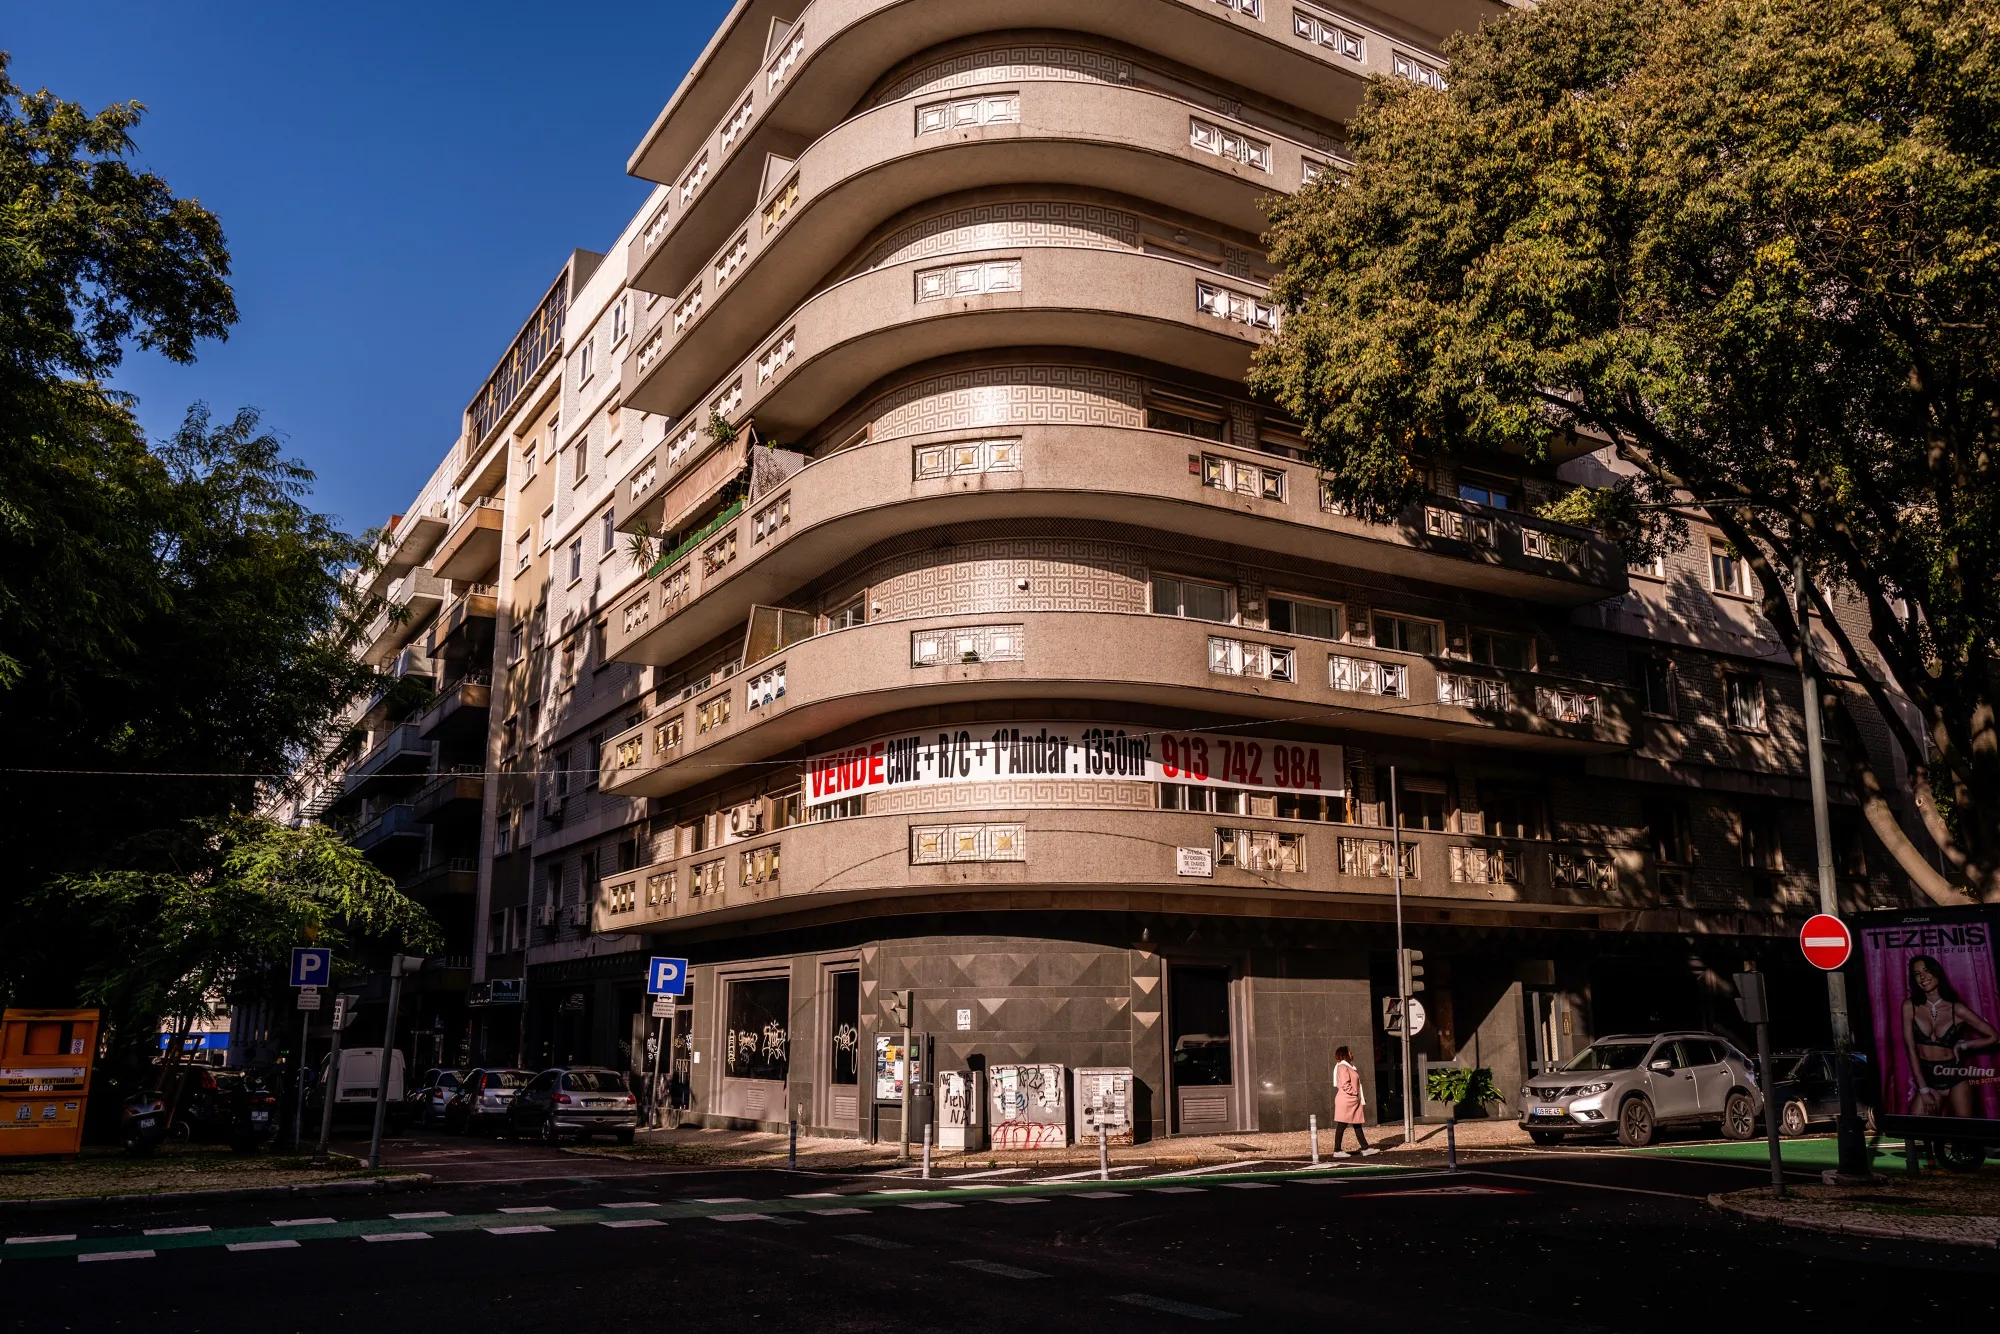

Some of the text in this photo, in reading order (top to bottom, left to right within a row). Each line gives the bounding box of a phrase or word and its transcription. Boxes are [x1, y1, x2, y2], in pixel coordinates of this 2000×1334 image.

[811, 741, 885, 798] VENDE
[887, 736, 920, 785] CAVE
[924, 744, 934, 770] +
[938, 731, 971, 778] R/C
[975, 739, 987, 766] +
[1161, 734, 1208, 781] 913
[1217, 739, 1263, 785] 742
[1273, 744, 1321, 790] 984
[1867, 924, 1985, 950] TEZENIS
[1923, 946, 1987, 955] underwear
[300, 953, 321, 981] P
[657, 963, 678, 989] P
[1933, 1065, 1995, 1077] Carolina
